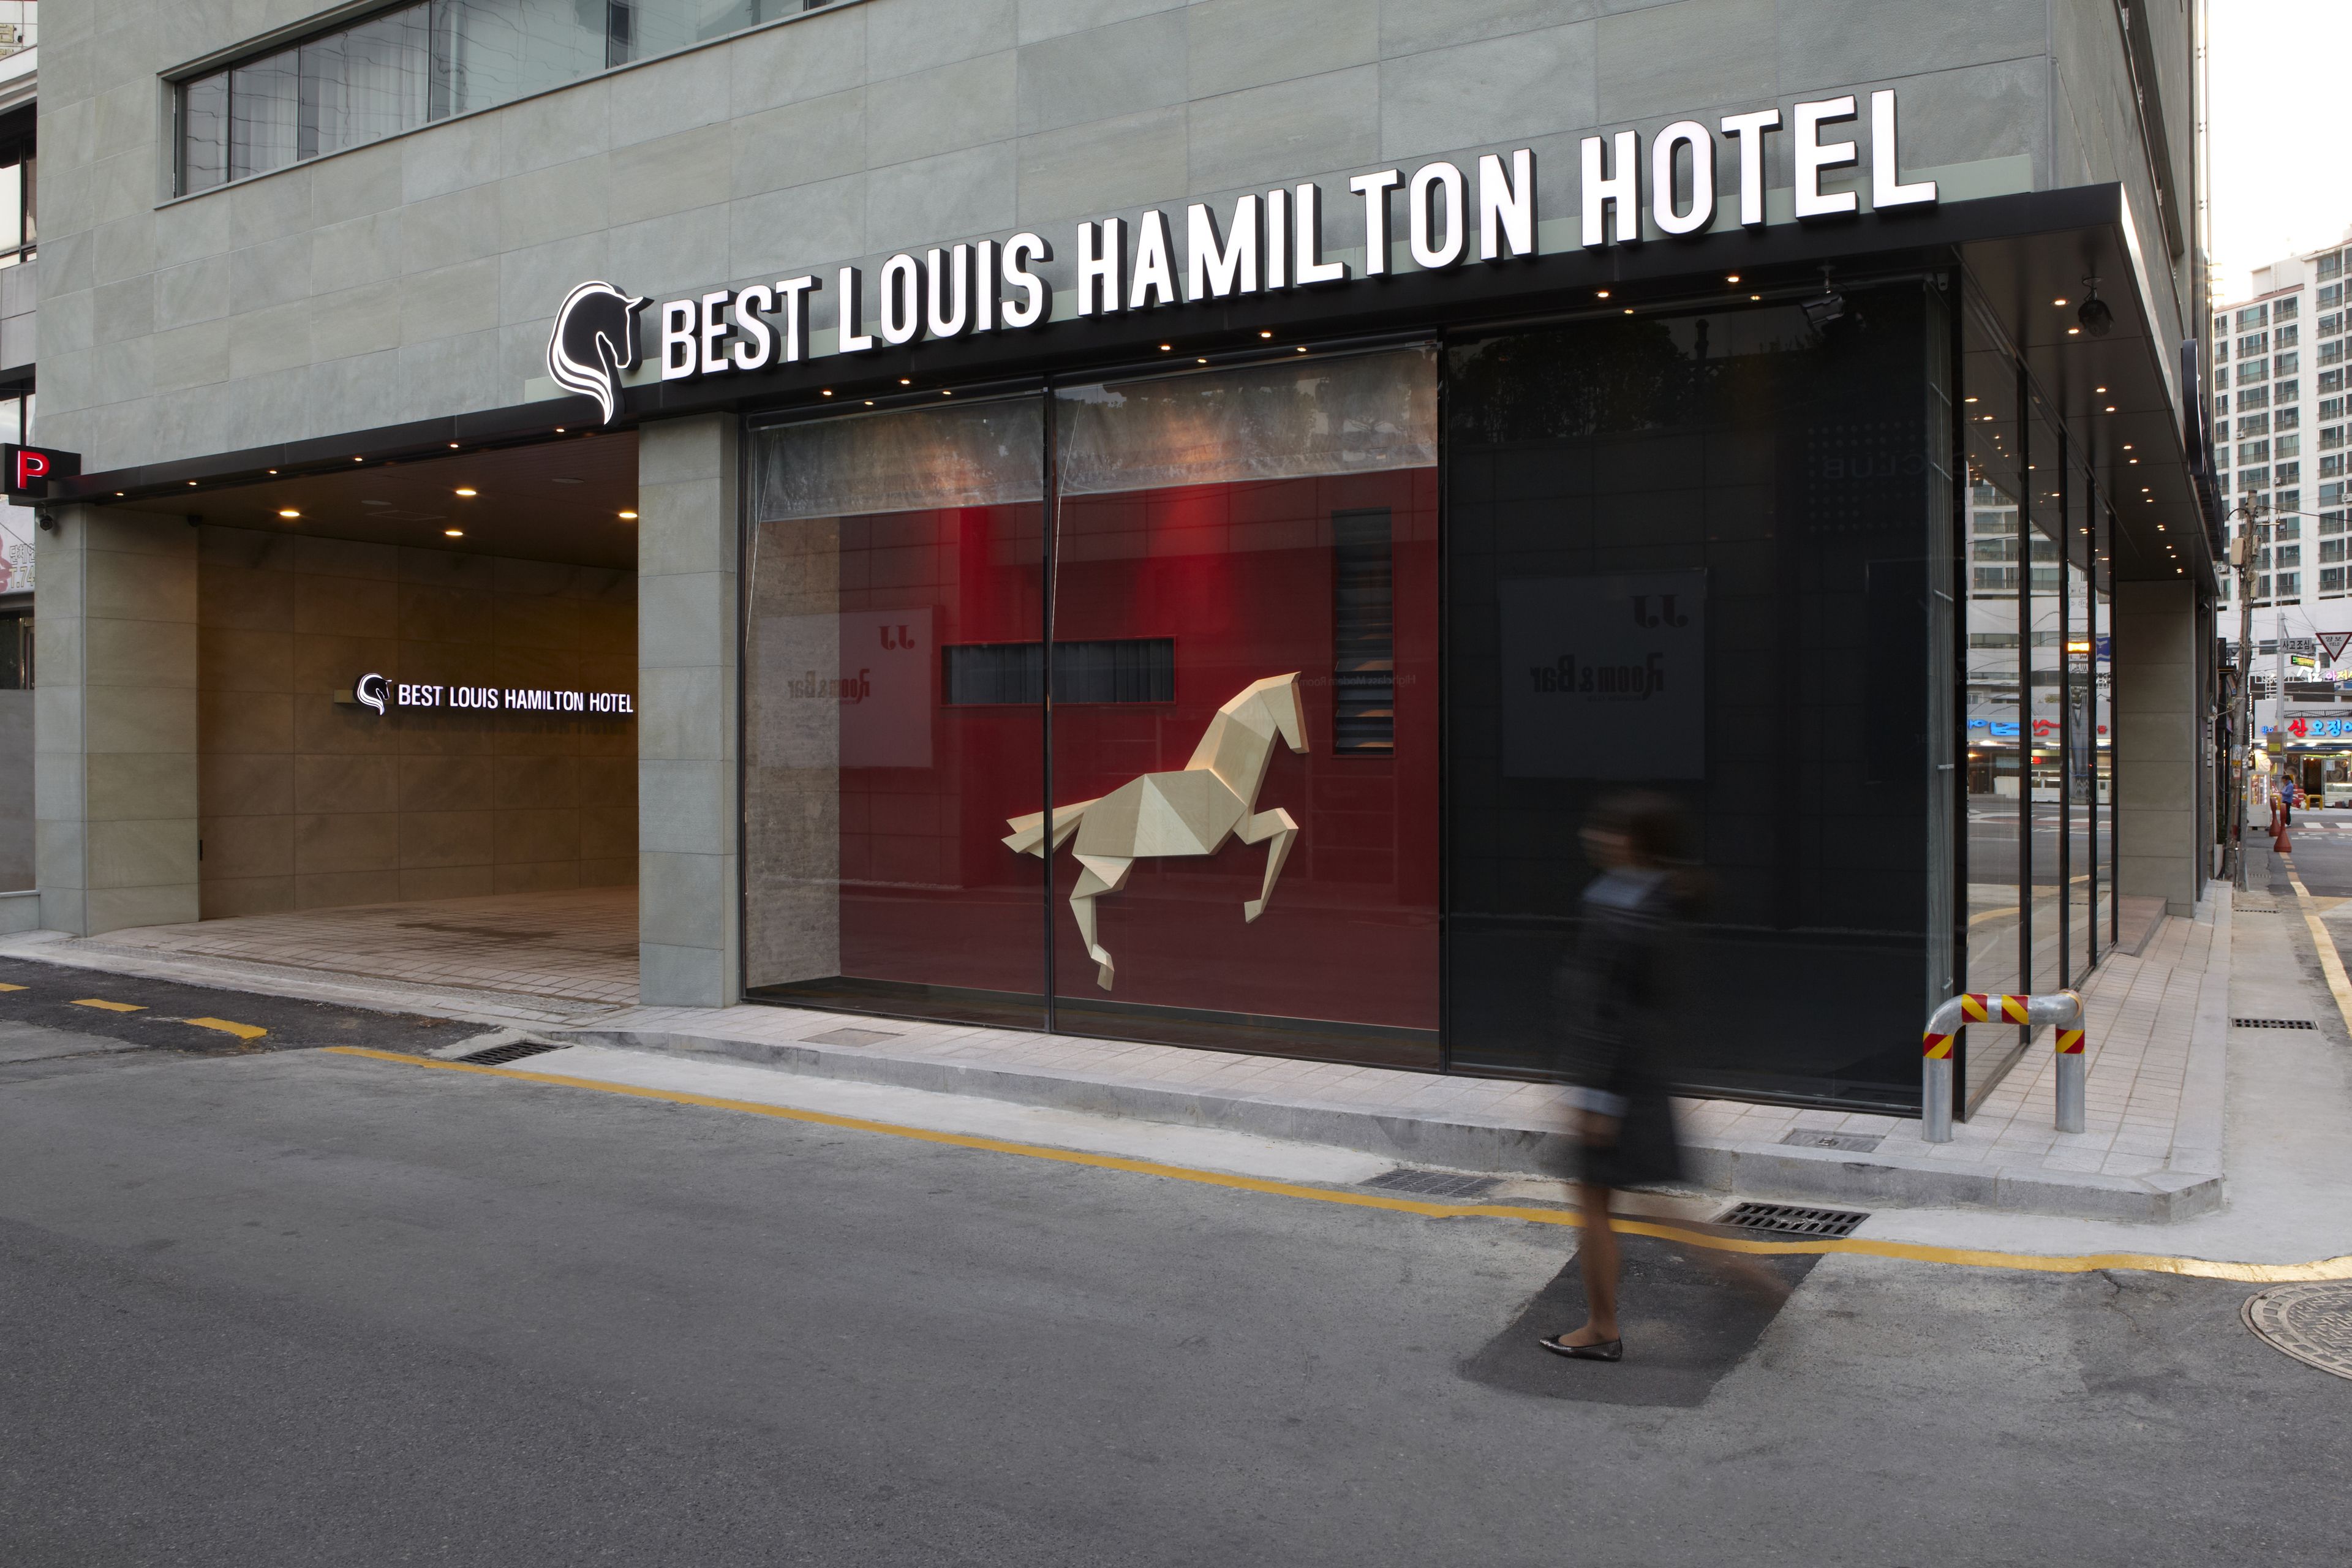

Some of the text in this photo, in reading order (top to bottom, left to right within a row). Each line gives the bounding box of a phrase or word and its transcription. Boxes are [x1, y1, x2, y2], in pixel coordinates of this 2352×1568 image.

[661, 89, 1937, 382] BEST LOUIS HAMILTON HOTEL
[17, 450, 51, 490] P
[398, 684, 634, 714] BEST LOUIS HAMILTON HOTEL
